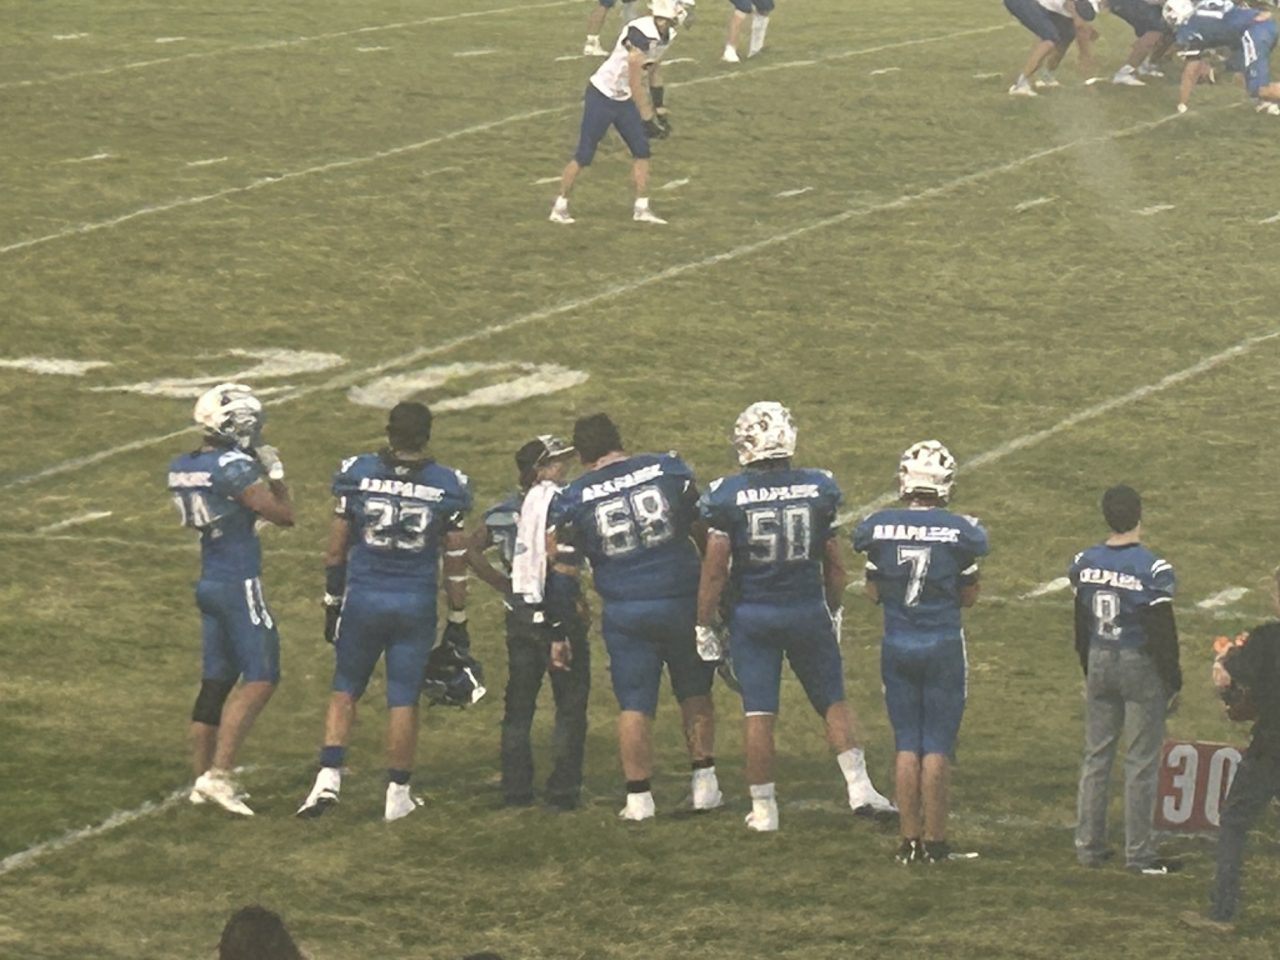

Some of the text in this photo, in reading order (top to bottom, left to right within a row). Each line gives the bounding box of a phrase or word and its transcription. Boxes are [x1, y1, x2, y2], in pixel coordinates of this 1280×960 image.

[746, 504, 811, 563] 50
[897, 544, 932, 608] 7
[1162, 744, 1243, 827] 30
